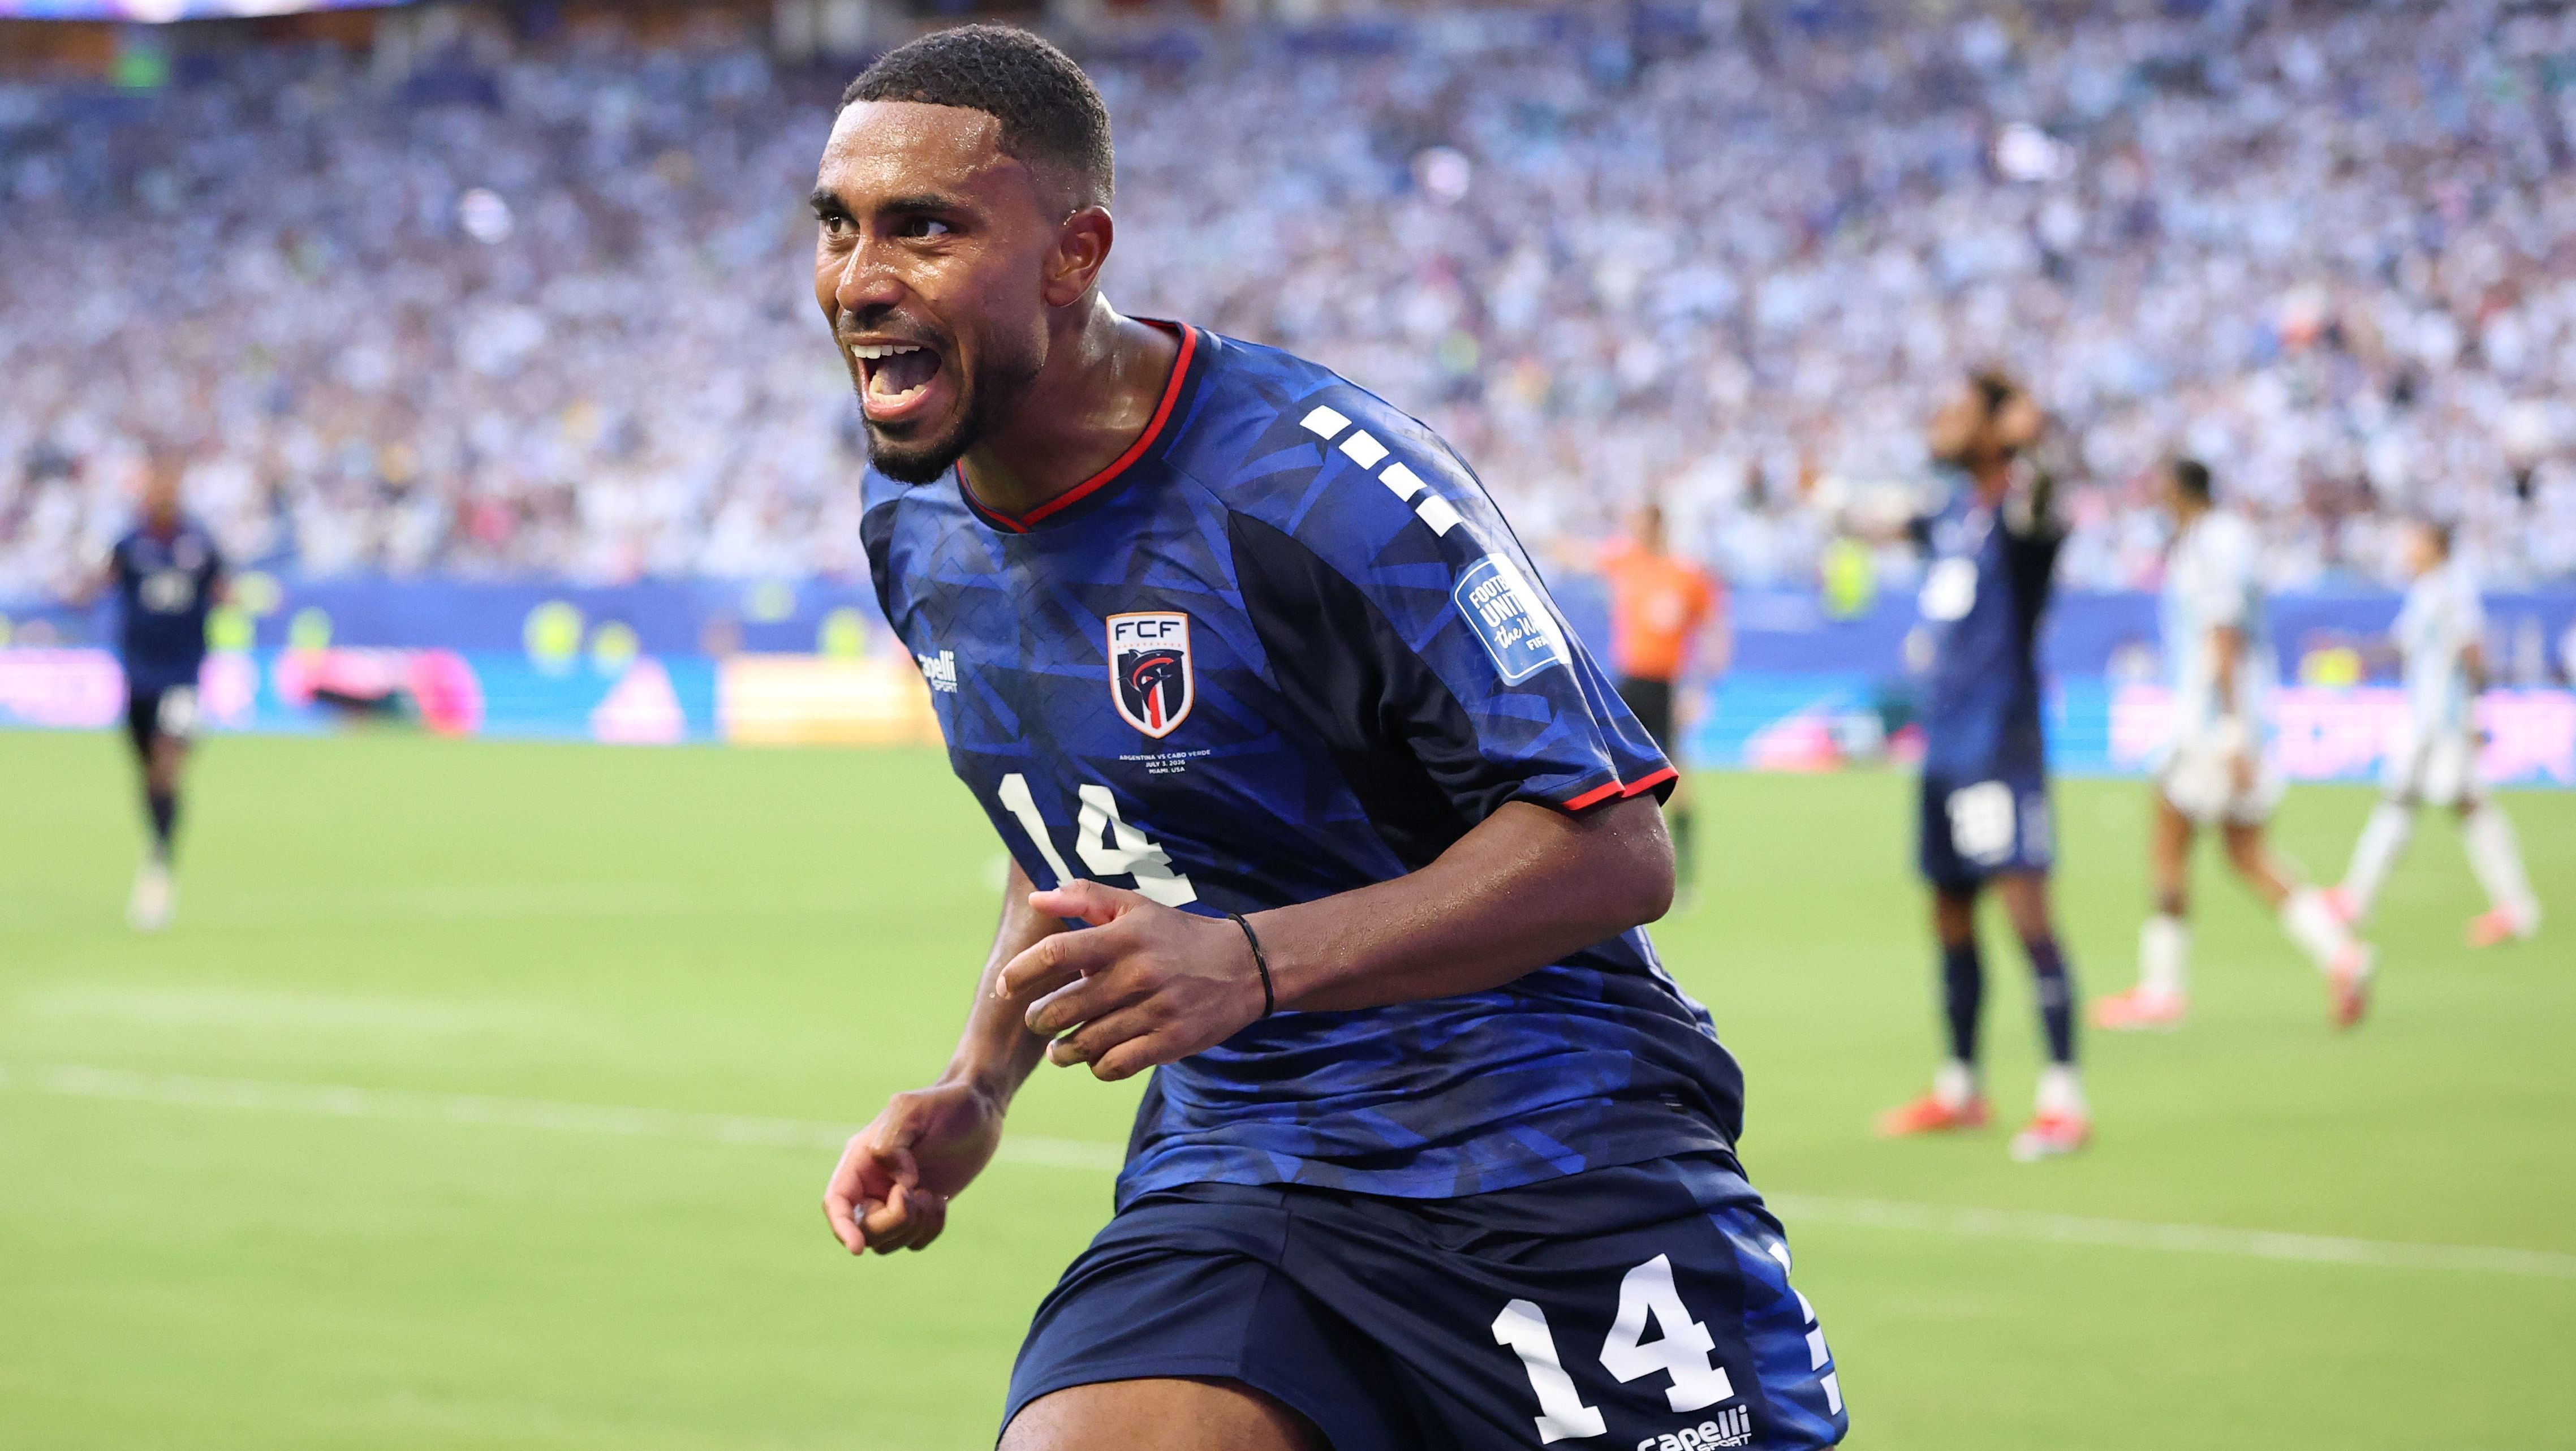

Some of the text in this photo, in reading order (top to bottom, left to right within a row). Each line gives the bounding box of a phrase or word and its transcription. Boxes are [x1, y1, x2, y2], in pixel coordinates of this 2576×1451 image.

[1469, 574, 1512, 609] FOOTB
[1480, 591, 1524, 627] UNIT
[1115, 621, 1180, 641] FCF
[1494, 625, 1522, 649] the
[1526, 635, 1549, 651] FIFA
[917, 649, 957, 682] apelli
[998, 773, 1198, 908] 14
[1491, 1253, 1734, 1445] 14
[1697, 1432, 1752, 1451] SPORT
